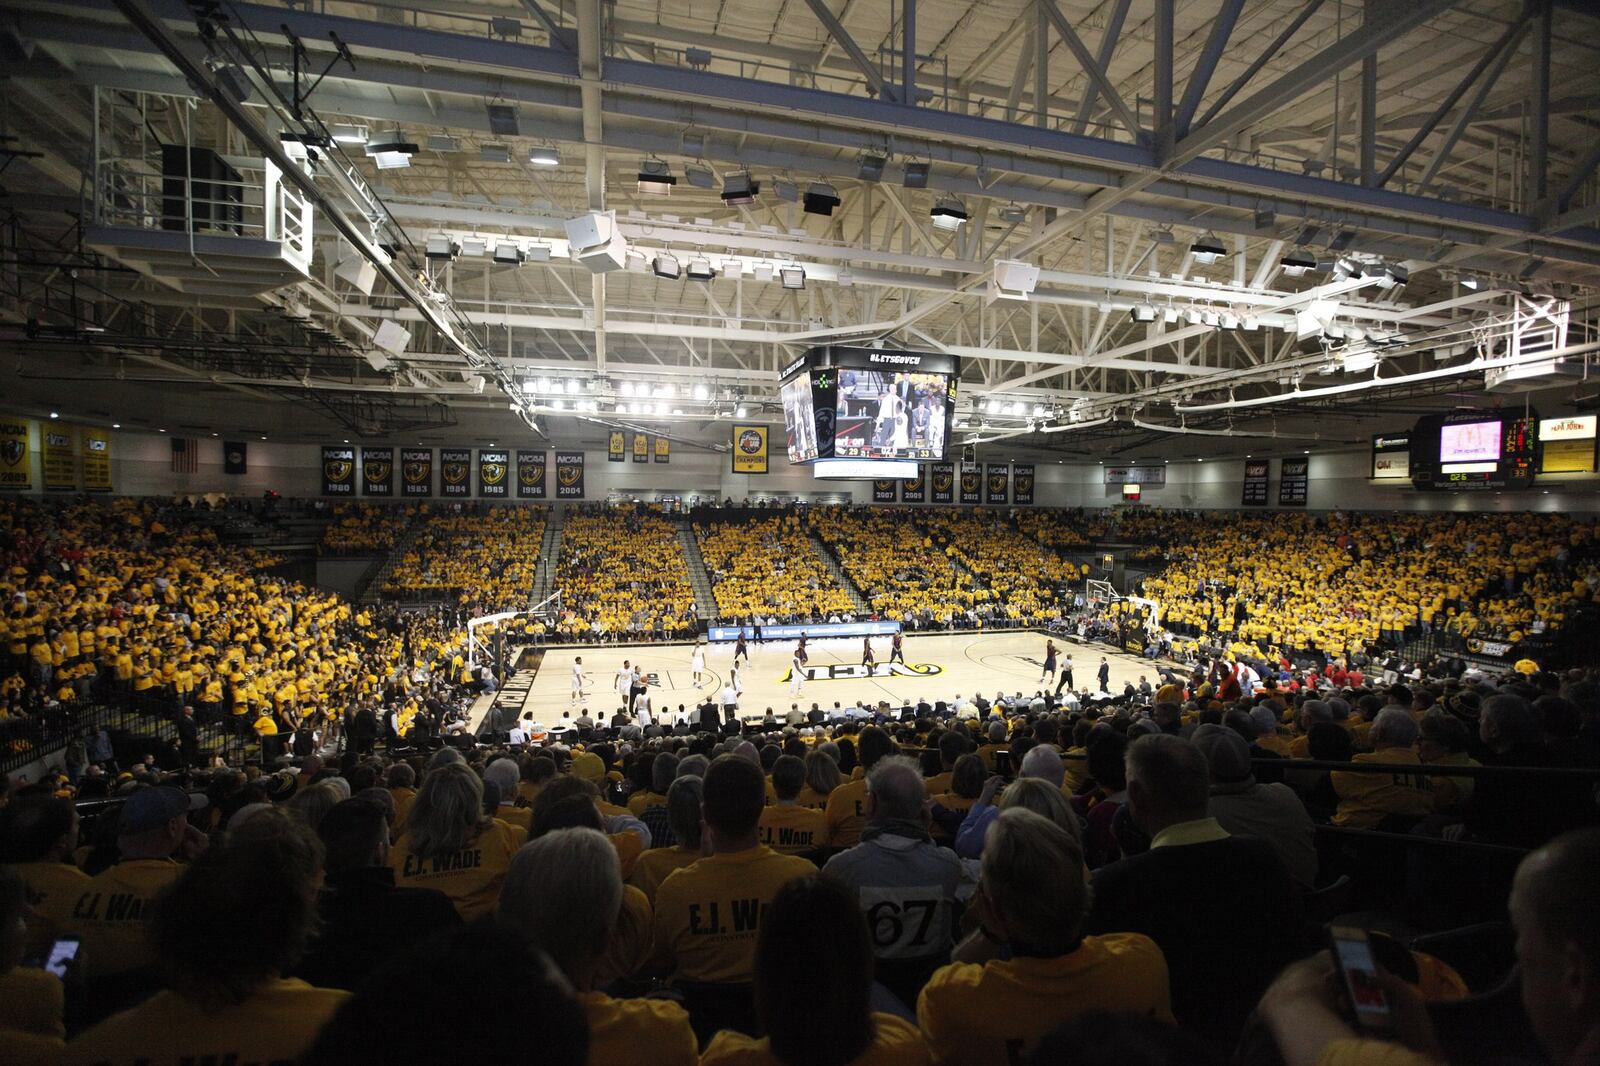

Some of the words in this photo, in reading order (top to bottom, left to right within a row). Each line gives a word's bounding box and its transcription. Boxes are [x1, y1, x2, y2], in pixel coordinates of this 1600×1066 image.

[324, 451, 353, 460] NCAA
[363, 452, 391, 460] NCAA
[402, 452, 430, 461] NCAA
[442, 453, 469, 462] NCAA
[480, 454, 506, 462] NCAA
[518, 455, 544, 463] NCAA
[557, 455, 582, 463] NCAA
[867, 899, 937, 946] 67
